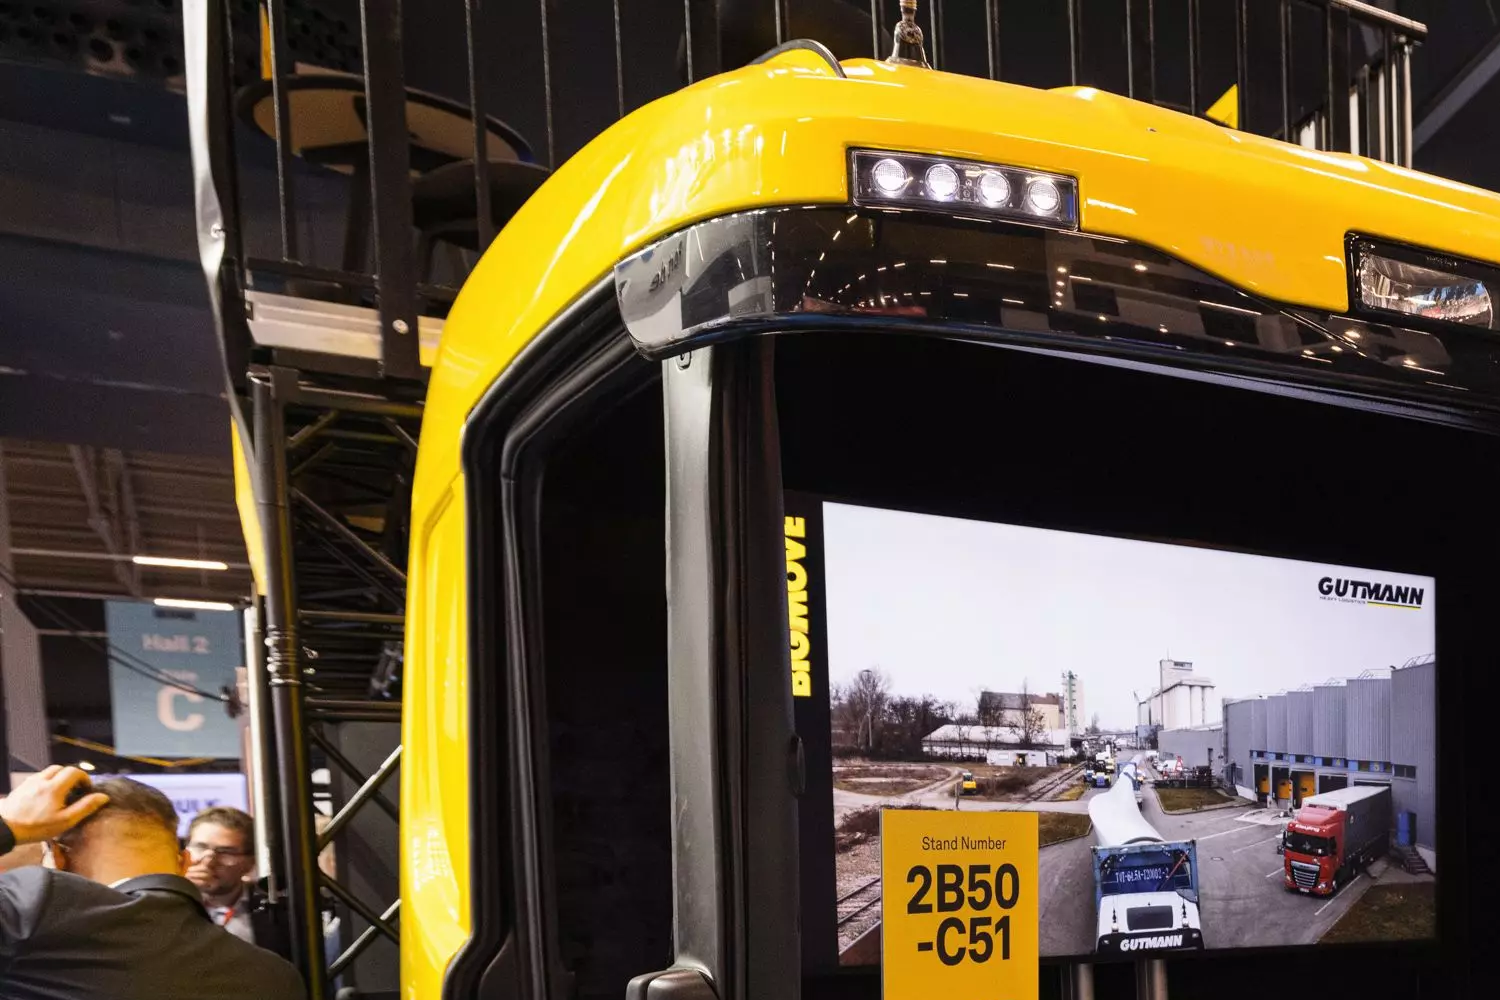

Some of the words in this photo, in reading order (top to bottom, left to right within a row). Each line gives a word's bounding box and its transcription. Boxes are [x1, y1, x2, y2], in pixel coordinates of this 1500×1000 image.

[1318, 576, 1424, 606] GUTMANN
[142, 634, 190, 652] Hall
[192, 635, 211, 654] 2
[157, 684, 205, 732] C
[922, 836, 958, 850] Stand
[962, 836, 1006, 850] Number
[906, 863, 1019, 914] 2B50
[918, 916, 1010, 966] -C51
[1120, 935, 1182, 952] GUTMANN
